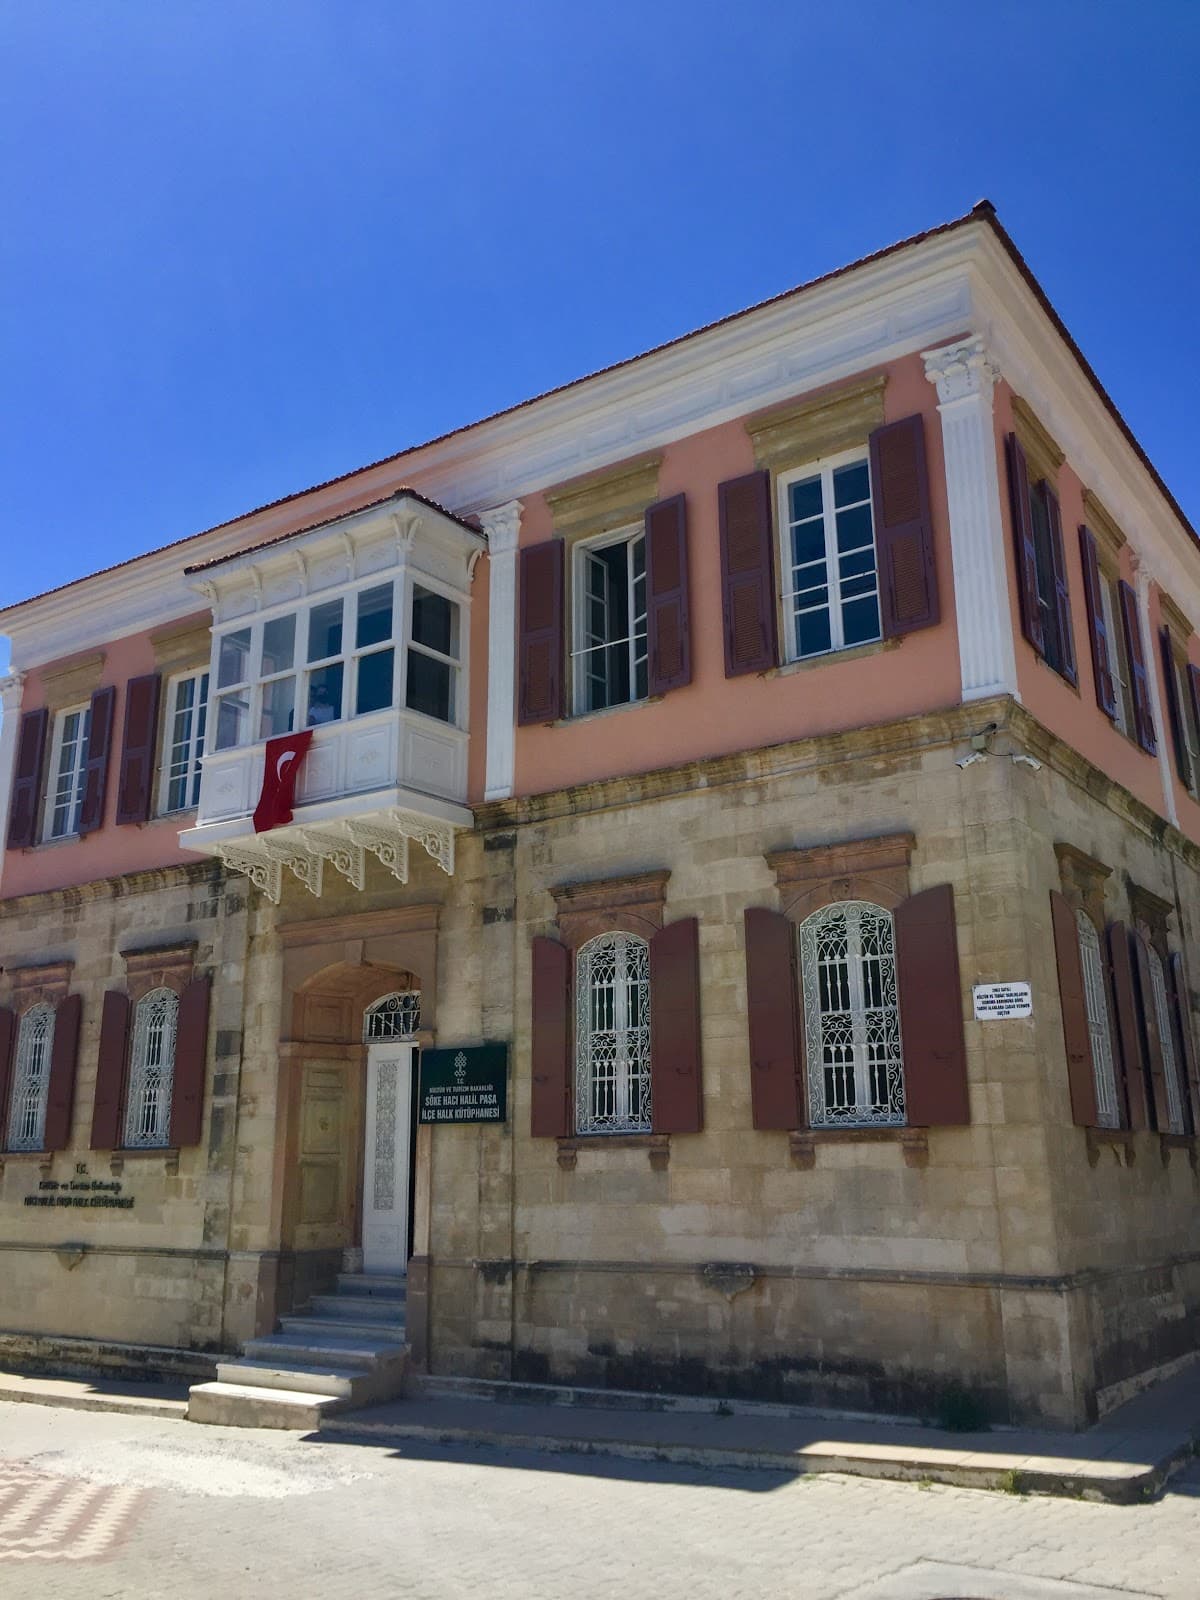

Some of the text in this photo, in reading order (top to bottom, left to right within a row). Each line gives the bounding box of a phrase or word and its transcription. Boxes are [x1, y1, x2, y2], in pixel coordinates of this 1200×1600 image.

[470, 1084, 494, 1092] BAKANLIĞI
[425, 1093, 497, 1106] SÖKE HACI HALİL PAŞA
[422, 1105, 499, 1120] İLÇE HALK KÜTÜPHANESİ
